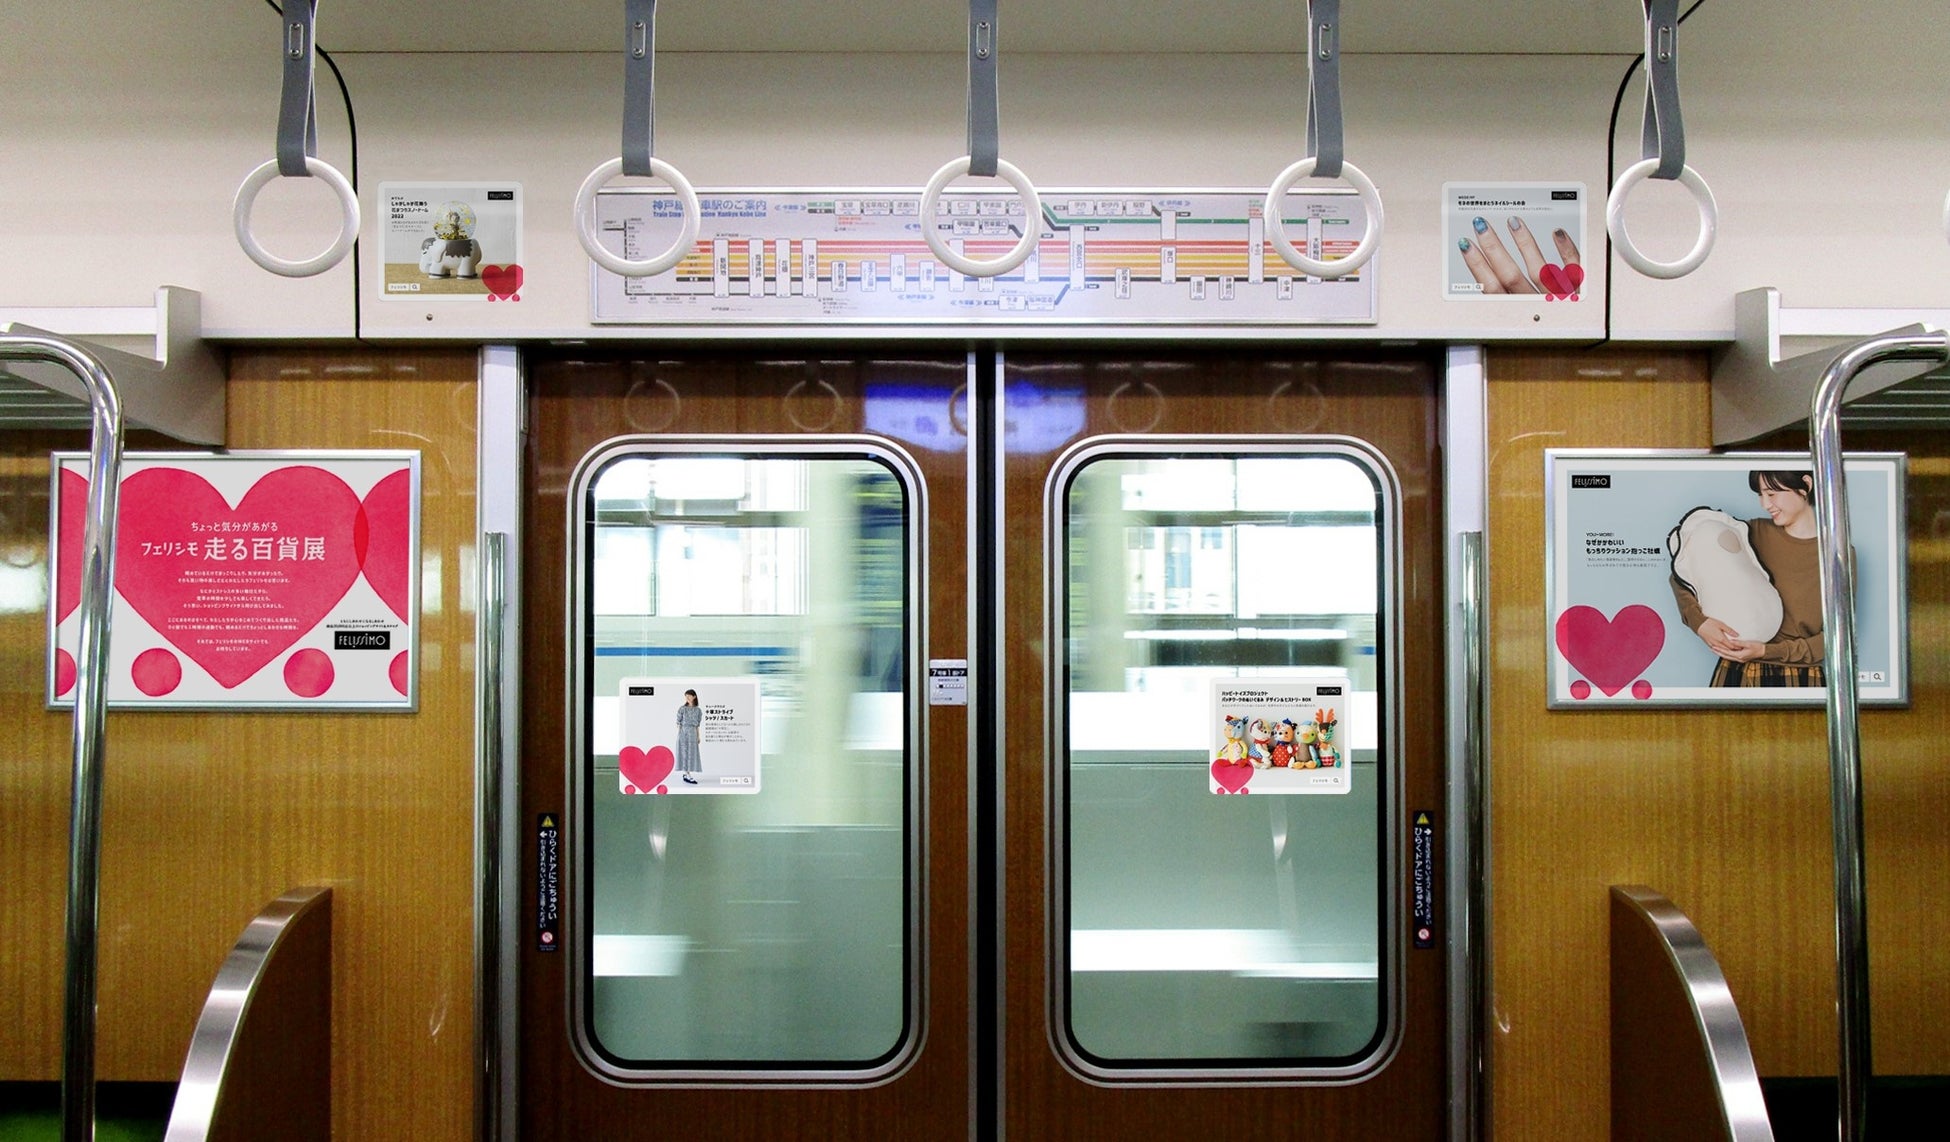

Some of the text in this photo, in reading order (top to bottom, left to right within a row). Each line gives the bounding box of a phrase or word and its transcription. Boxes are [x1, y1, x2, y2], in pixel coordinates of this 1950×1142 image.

[190, 521, 279, 532] ちょっと気分があがる
[140, 536, 326, 562] フェリシモ 走る百貨展
[338, 633, 386, 648] FELISSIMO
